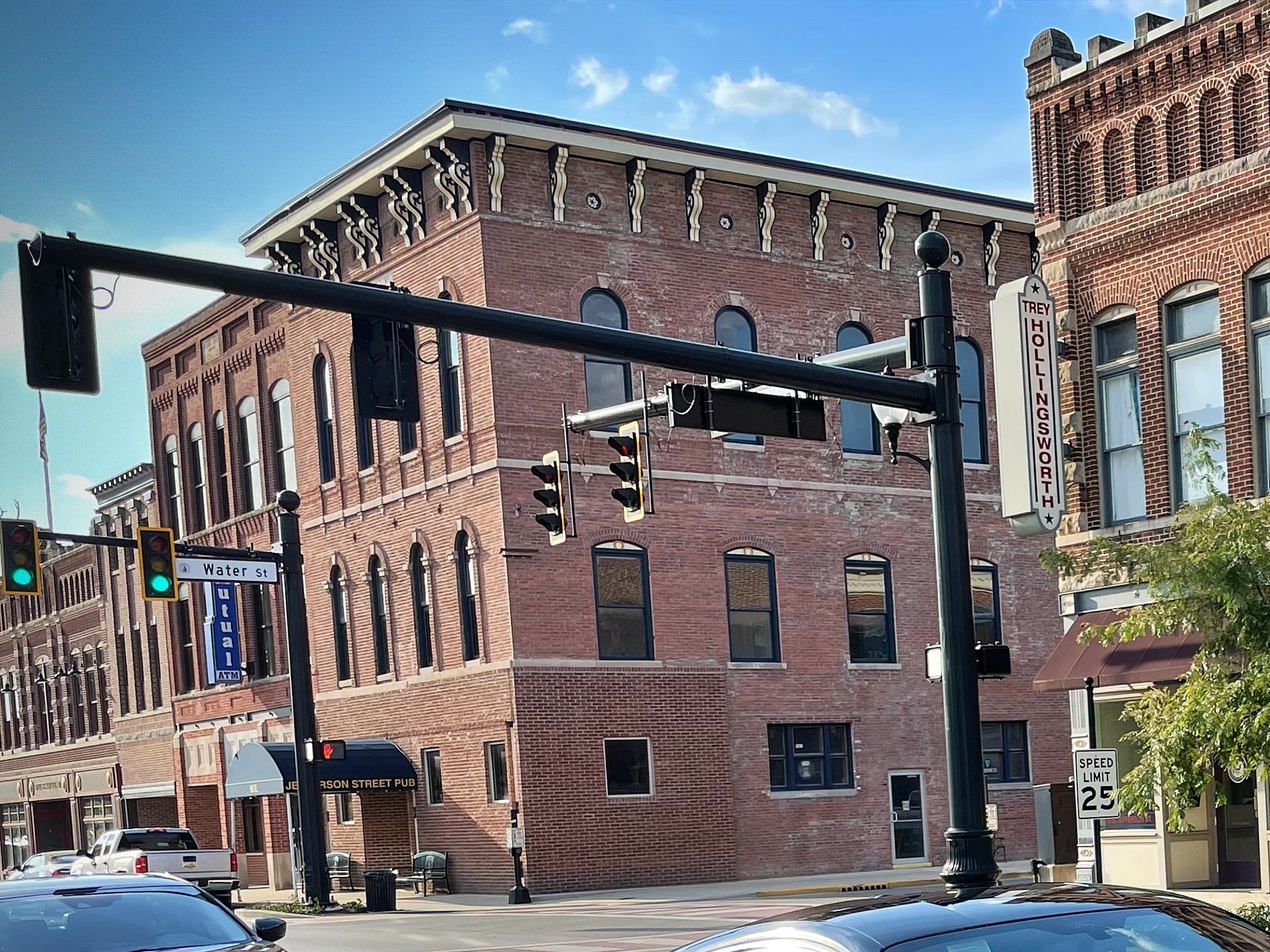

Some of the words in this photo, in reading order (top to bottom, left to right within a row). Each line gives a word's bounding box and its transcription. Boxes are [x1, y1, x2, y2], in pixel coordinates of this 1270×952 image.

[1022, 300, 1050, 316] TREY
[1031, 318, 1054, 508] HOLLINGSWORTH
[203, 563, 248, 577] Water
[256, 568, 268, 578] St
[217, 582, 234, 667] utual
[217, 671, 240, 680] ATM
[1079, 757, 1114, 769] SPEED
[351, 778, 391, 789] STREET
[394, 778, 416, 788] PUB
[1083, 771, 1110, 783] LIMIT
[1081, 786, 1115, 811] 25
